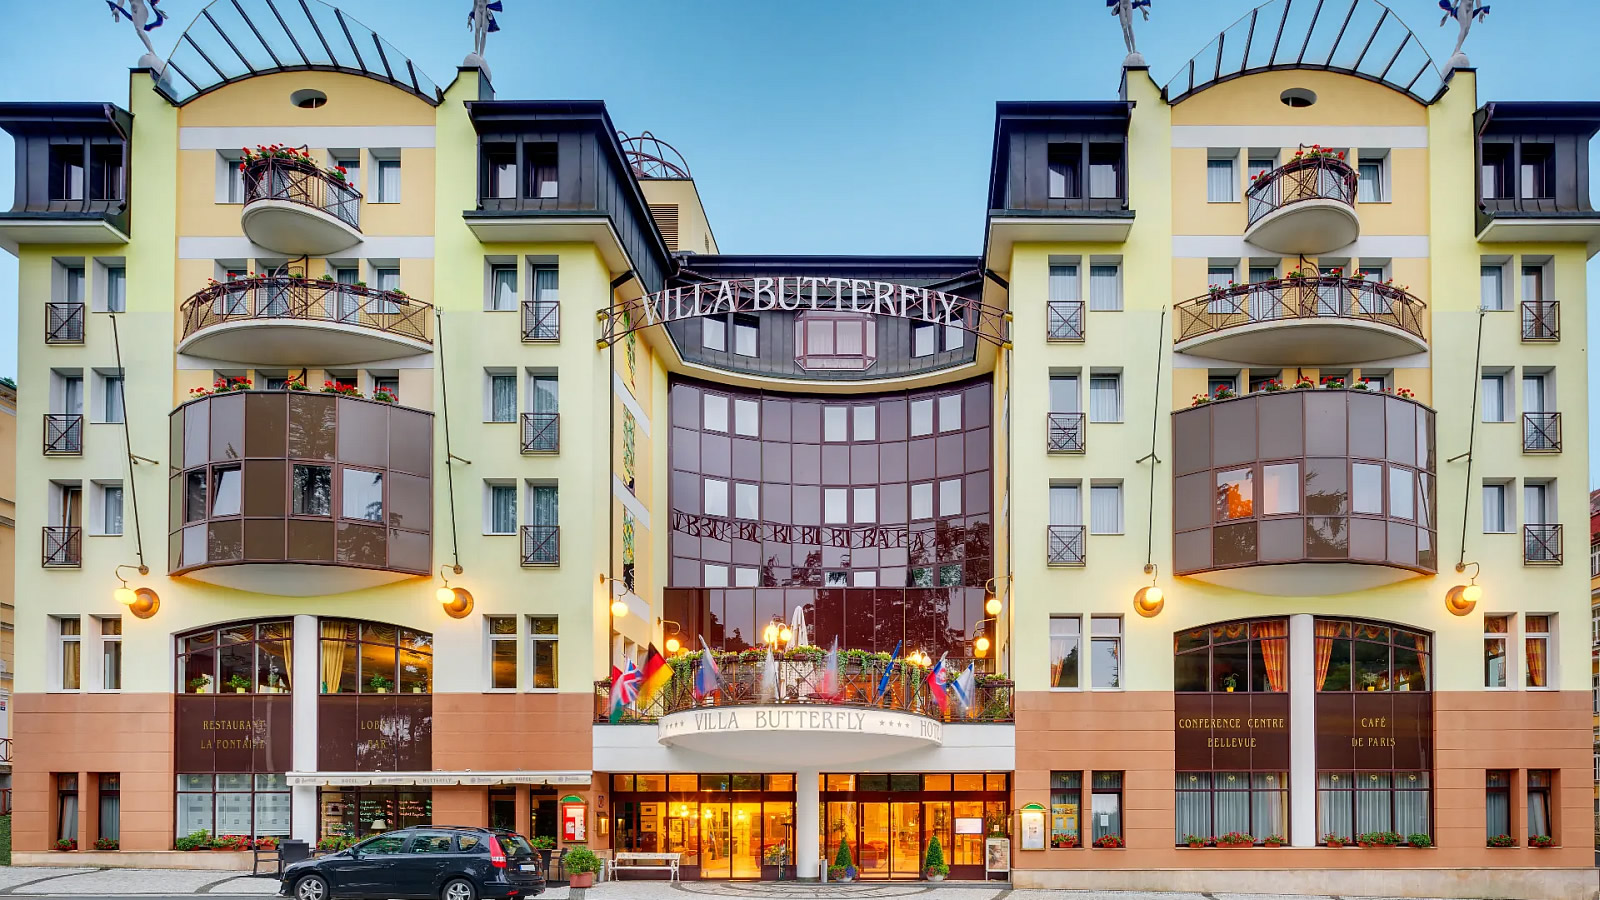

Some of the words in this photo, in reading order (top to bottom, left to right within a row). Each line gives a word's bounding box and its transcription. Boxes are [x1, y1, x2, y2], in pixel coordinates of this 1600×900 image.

[642, 280, 736, 326] VILLA
[753, 276, 958, 326] BUTTERFLY
[203, 720, 266, 730] RESTAURANT
[695, 711, 739, 730] VILLA
[755, 710, 866, 730] BUTTERFLY
[920, 720, 942, 741] HOT
[1178, 718, 1241, 729] CONFERENCE
[1247, 718, 1284, 729] CENTRE
[1361, 715, 1386, 728] CAFÉ
[200, 739, 212, 749] LA
[367, 739, 387, 749] BAR
[1207, 737, 1257, 748] BELLEVUE
[1351, 737, 1364, 747] DE
[1368, 737, 1396, 747] PARIS
